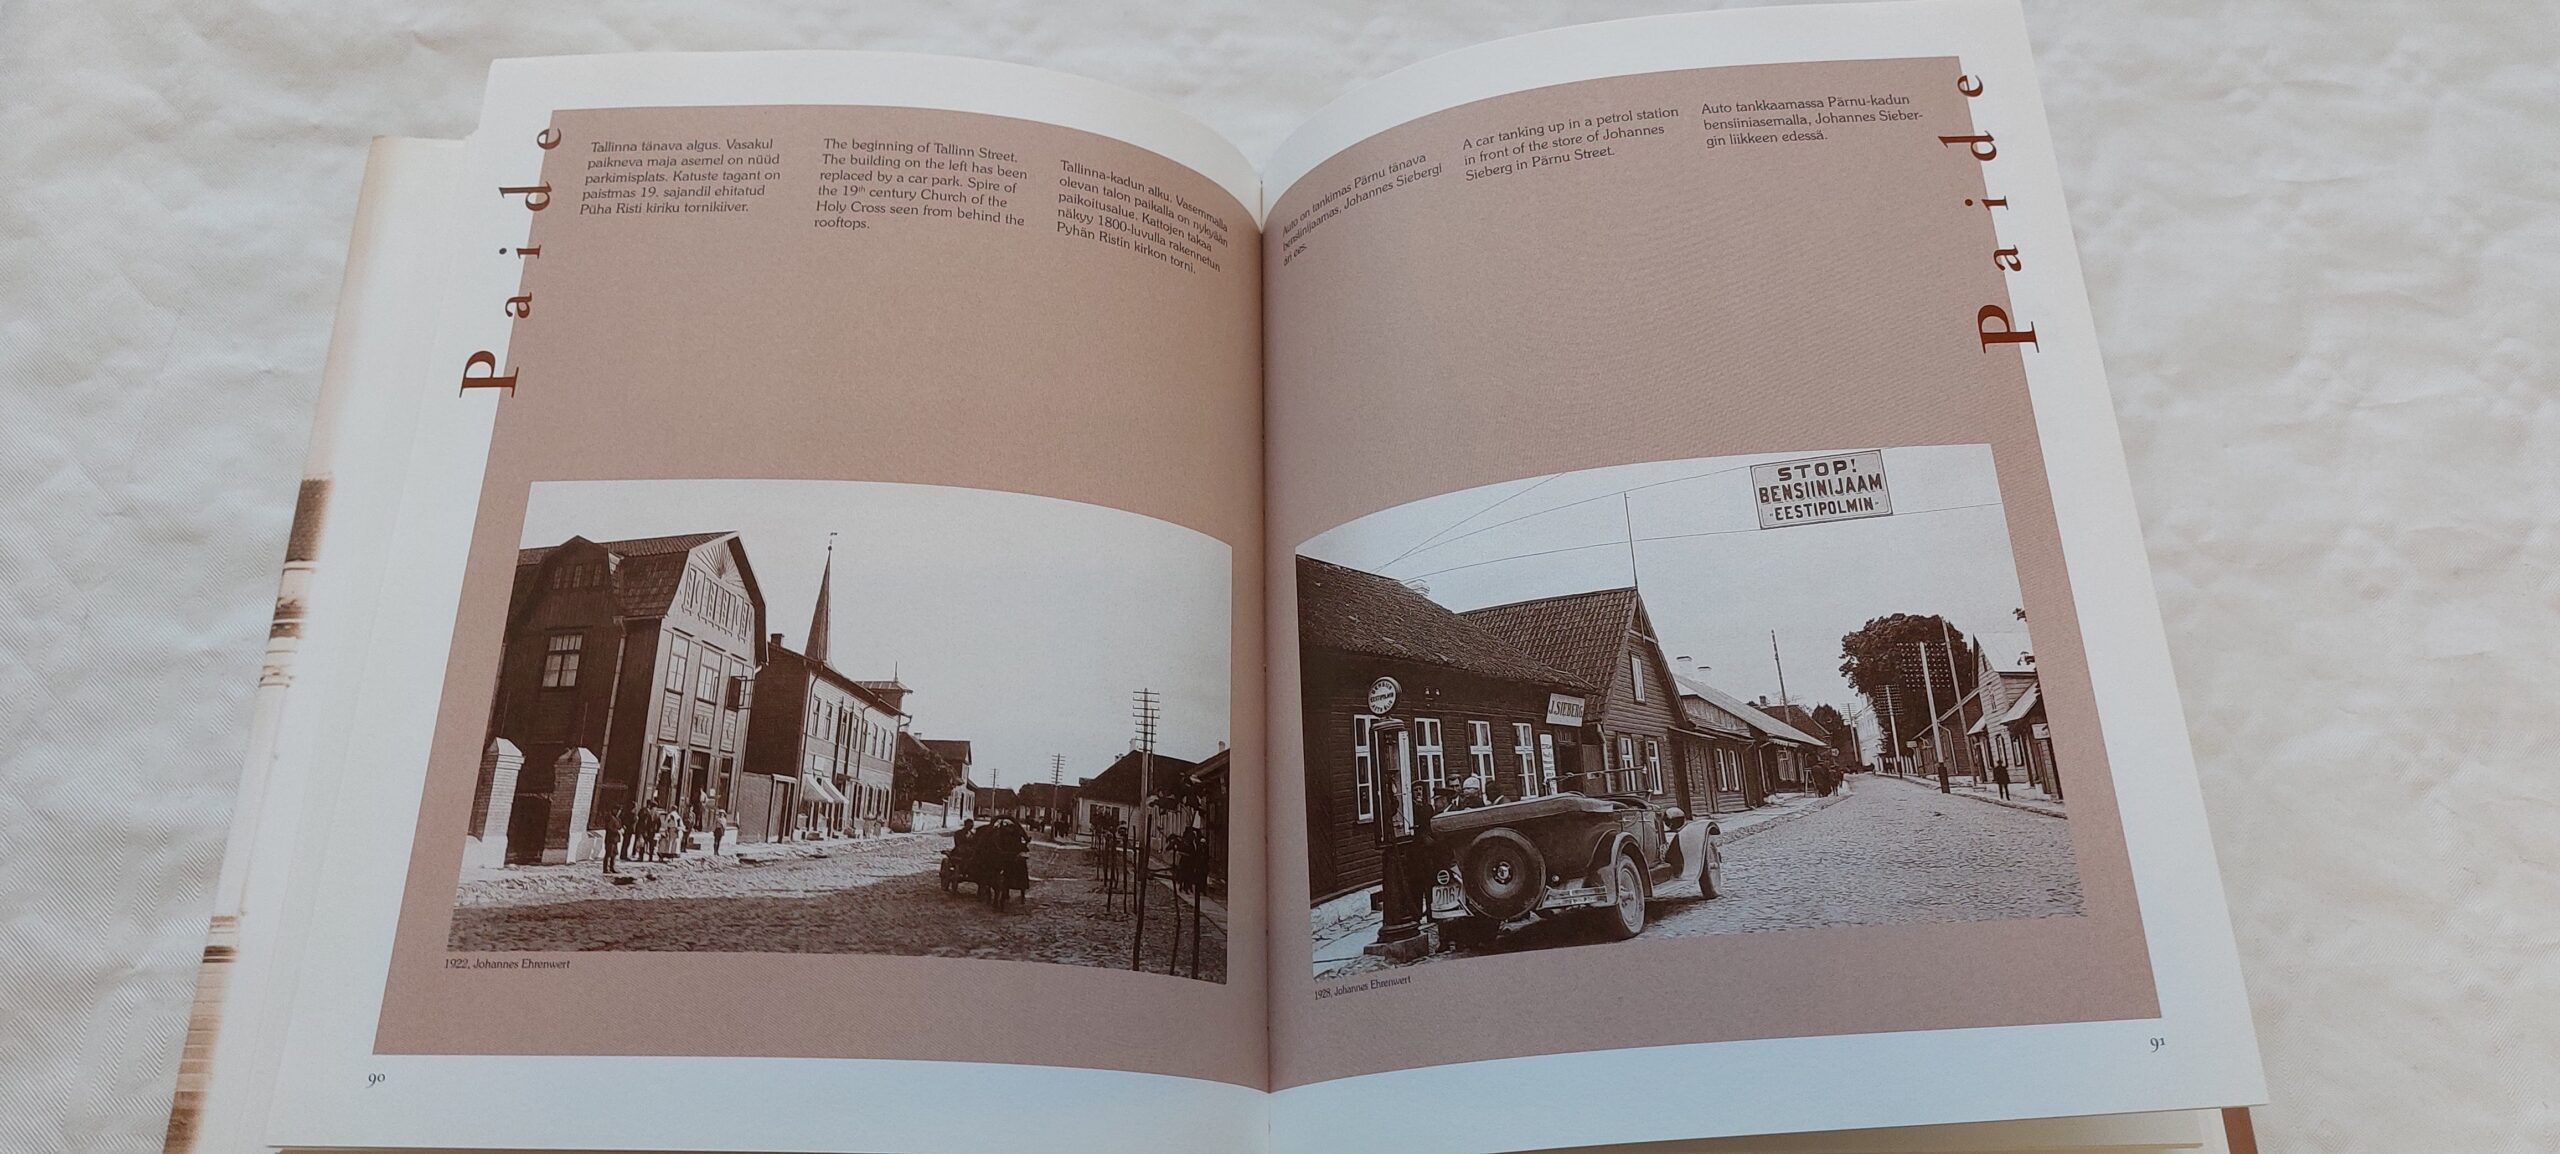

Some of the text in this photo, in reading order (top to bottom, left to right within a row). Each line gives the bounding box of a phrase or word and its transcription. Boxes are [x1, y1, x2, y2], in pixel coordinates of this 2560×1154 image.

[1702, 94, 1910, 114] Auto tankkaamassa Pärnu-kadun
[1463, 107, 1679, 150] A car tanking up in a petrol station
[1704, 110, 1923, 130] bensiiniasemalla, Johannes Sieber-
[591, 138, 773, 153] Tallinna tänava algus. Vasakul
[824, 138, 1018, 163] The beginning of Tallinn Street.
[1464, 125, 1665, 165] in front of the store of Johannes
[1706, 130, 1828, 148] gin liikkeen edessä.
[587, 154, 780, 170] paikneva maja asemel on nüüd
[822, 154, 1027, 180] The building on the left has been
[1465, 146, 1615, 181] Sieberg in Pärnu Street.
[585, 171, 780, 185] parkimisplats. Katuste tagant on
[820, 170, 1018, 194] replaced by a car park. Spire of
[1312, 185, 1352, 213] tankimas
[1354, 168, 1386, 189] Pärnu
[1389, 154, 1426, 174] tänava
[582, 185, 765, 201] paistmas 19. sajandil ehitatud
[818, 185, 838, 196] the
[869, 188, 916, 200] century
[920, 189, 967, 203] Church
[971, 194, 984, 205] of
[988, 196, 1007, 208] the
[1059, 176, 1099, 194] olevan
[1103, 187, 1131, 203] talon
[1135, 197, 1174, 219] paikalla
[1178, 213, 1190, 225] on
[1060, 160, 1227, 232] Tallinna-kadun alku. Vasemmalla
[1344, 183, 1393, 210] Johannes
[580, 201, 749, 215] Püha Risti kiriku tornikiiver.
[816, 200, 1024, 226] Holy Cross seen from behind the
[1938, 75, 2039, 354] Paide
[814, 218, 870, 230] rooftops.
[1058, 192, 1212, 252] paikoitusalue. Kattojen takaa
[1057, 221, 1196, 273] Pyhän Ristin kirkon torni.
[1058, 207, 1220, 272] näkyy 1800-luvulla rakennetun
[459, 127, 562, 399] Paide
[1778, 459, 1856, 481] STOP!
[1759, 473, 1882, 503] BENSIINIJAAM
[473, 959, 519, 969] Johannes
[522, 959, 570, 968] Ehrenwert
[1334, 984, 1368, 996] Johannes
[2150, 1037, 2165, 1053] 91
[365, 1072, 386, 1089] 90
